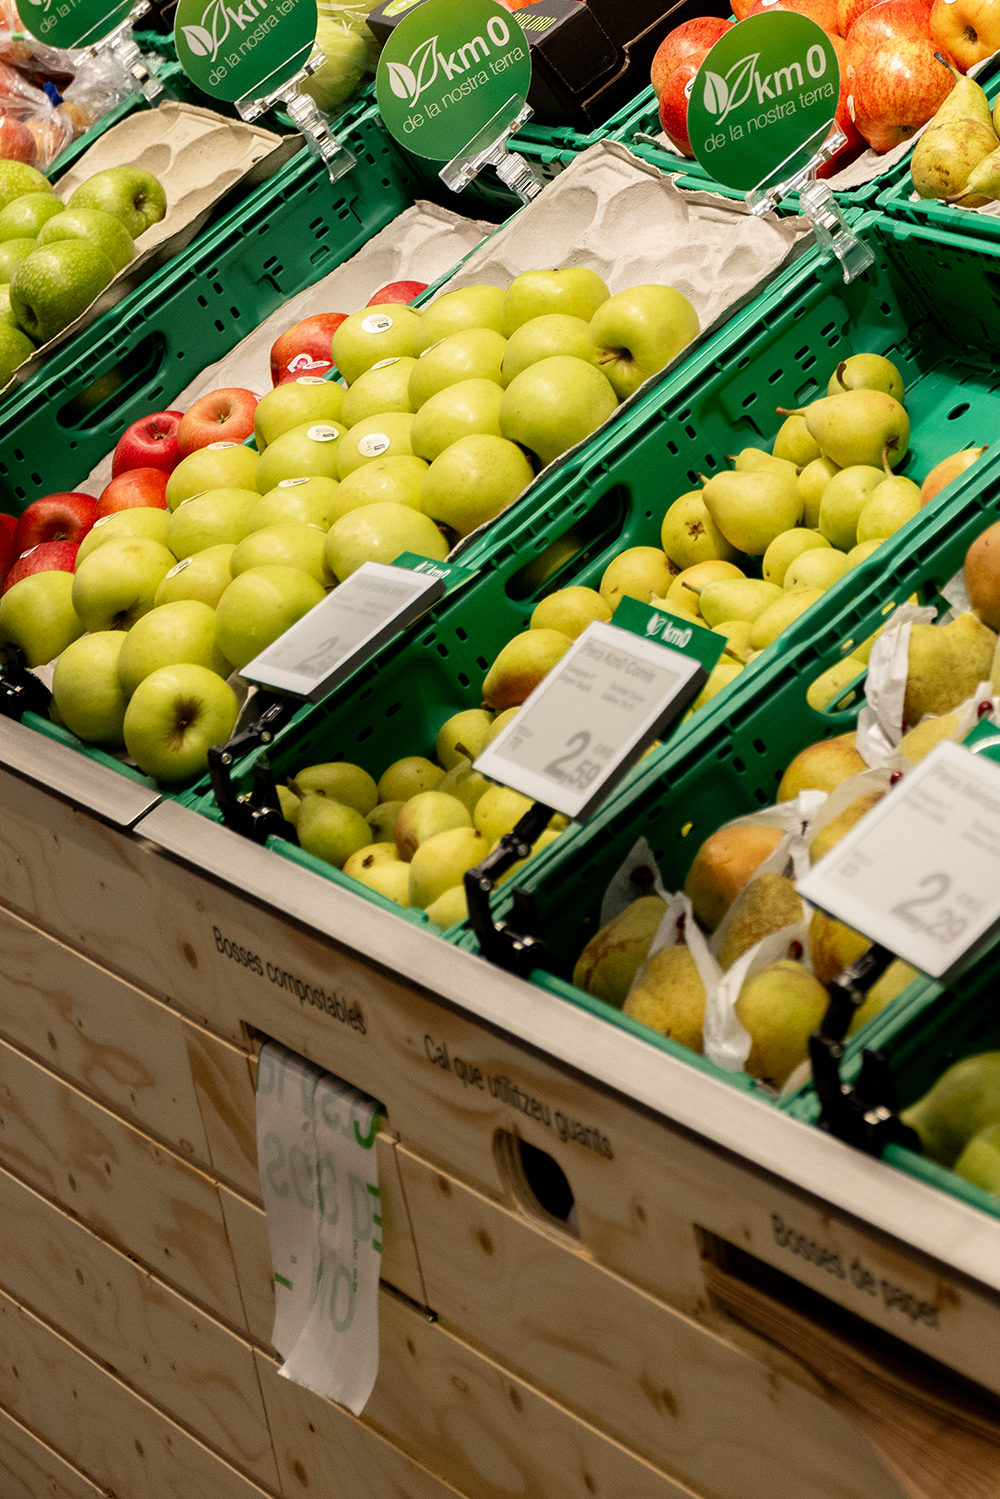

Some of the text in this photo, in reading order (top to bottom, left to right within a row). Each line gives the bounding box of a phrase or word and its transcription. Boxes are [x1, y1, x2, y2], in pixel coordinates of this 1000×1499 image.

[437, 16, 510, 81] km 0
[754, 44, 826, 105] km 0
[403, 47, 525, 133] de la nostra terra
[661, 621, 693, 648] km0
[212, 926, 368, 1036] Bosses compostables
[424, 1034, 616, 1161] Cal que utilitzeu guants
